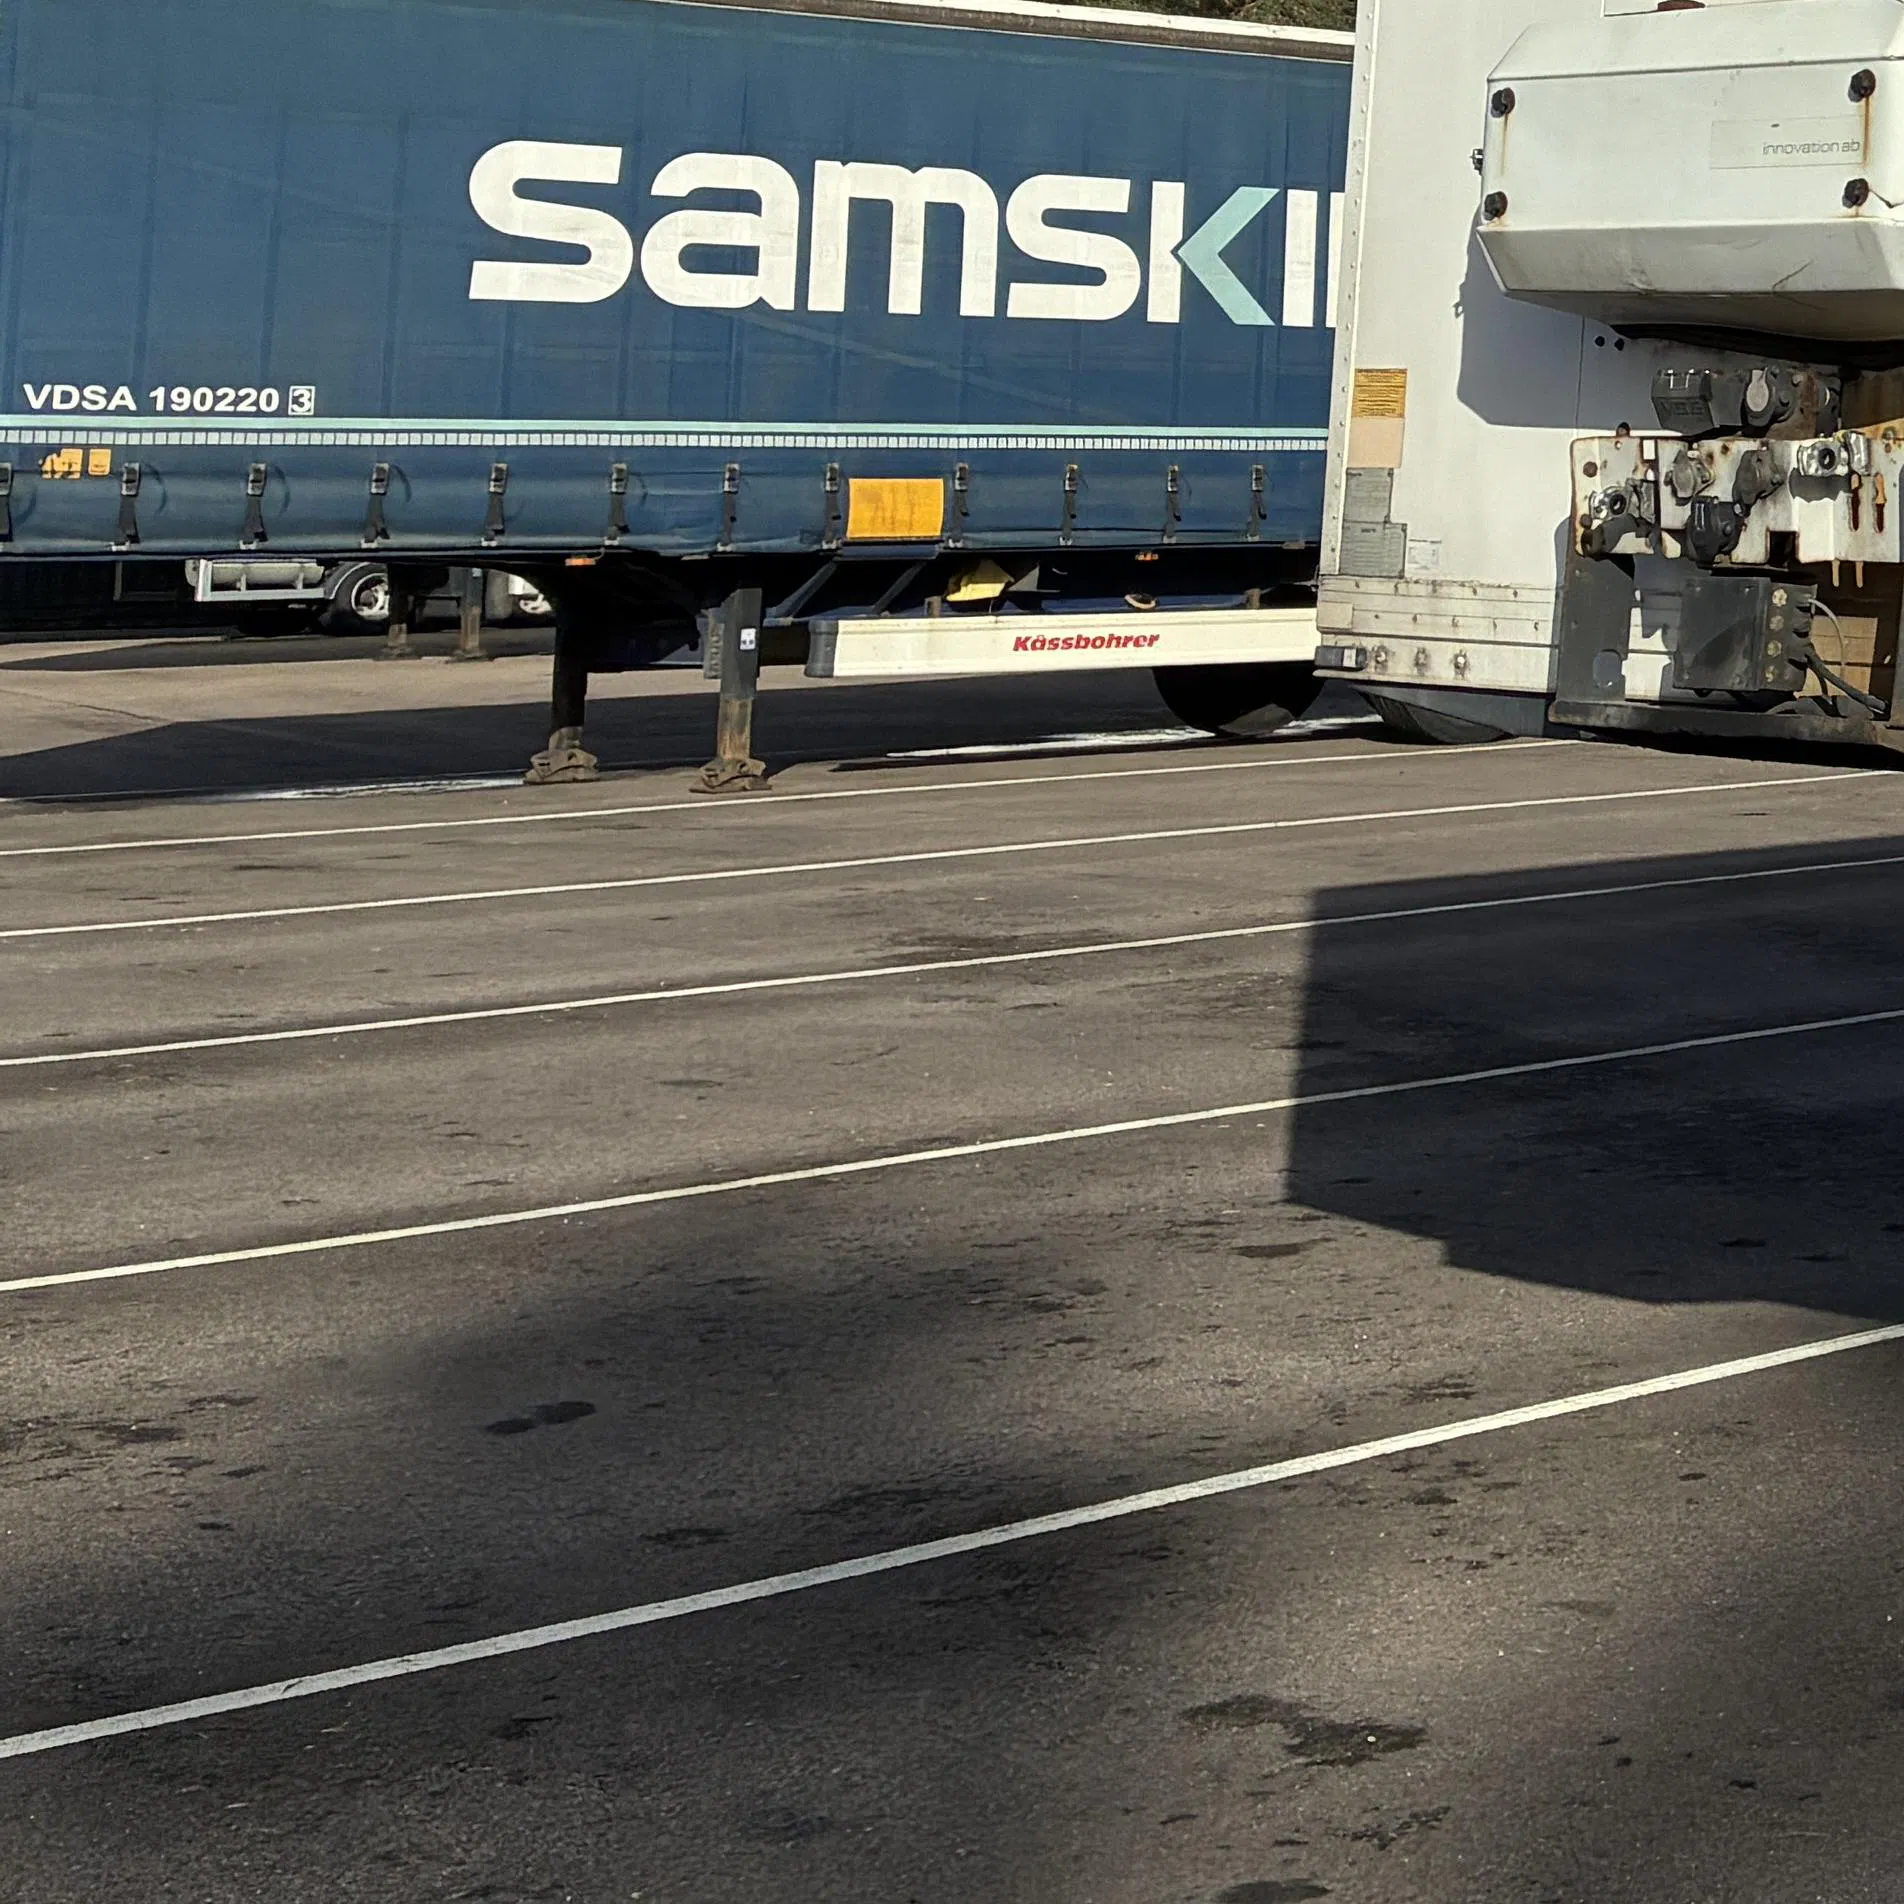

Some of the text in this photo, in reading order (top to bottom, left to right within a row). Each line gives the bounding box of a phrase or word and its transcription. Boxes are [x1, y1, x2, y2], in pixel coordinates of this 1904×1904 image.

[1762, 141, 1839, 156] innovation
[22, 383, 314, 414] VDSA 190220 3
